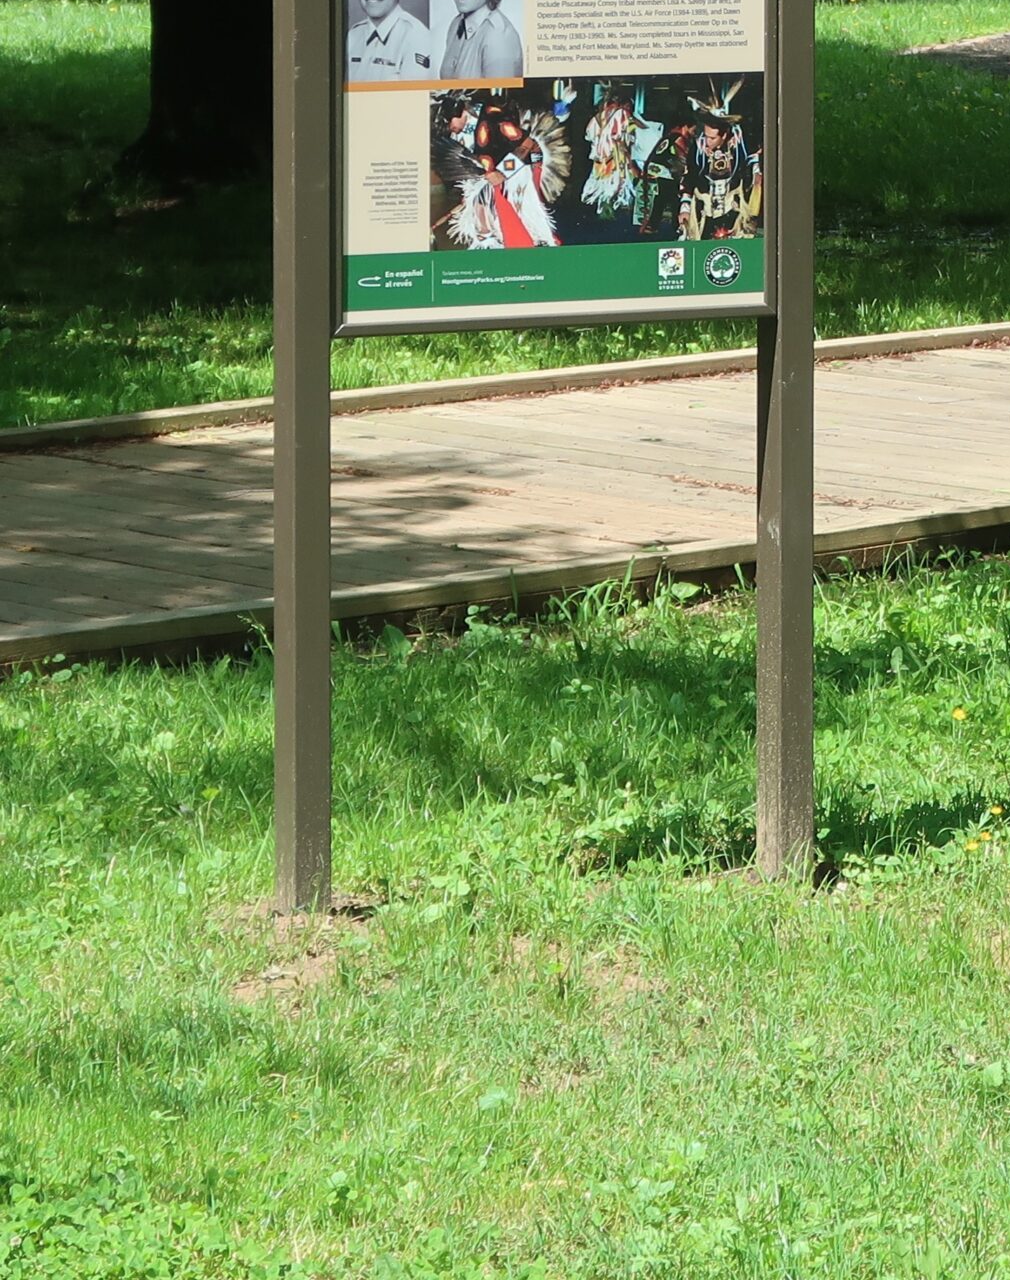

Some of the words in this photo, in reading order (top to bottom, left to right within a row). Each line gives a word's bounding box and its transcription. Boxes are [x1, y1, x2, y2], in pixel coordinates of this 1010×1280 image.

[385, 270, 394, 278] En
[395, 269, 423, 279] español
[385, 280, 392, 288] al
[392, 279, 412, 288] revés
